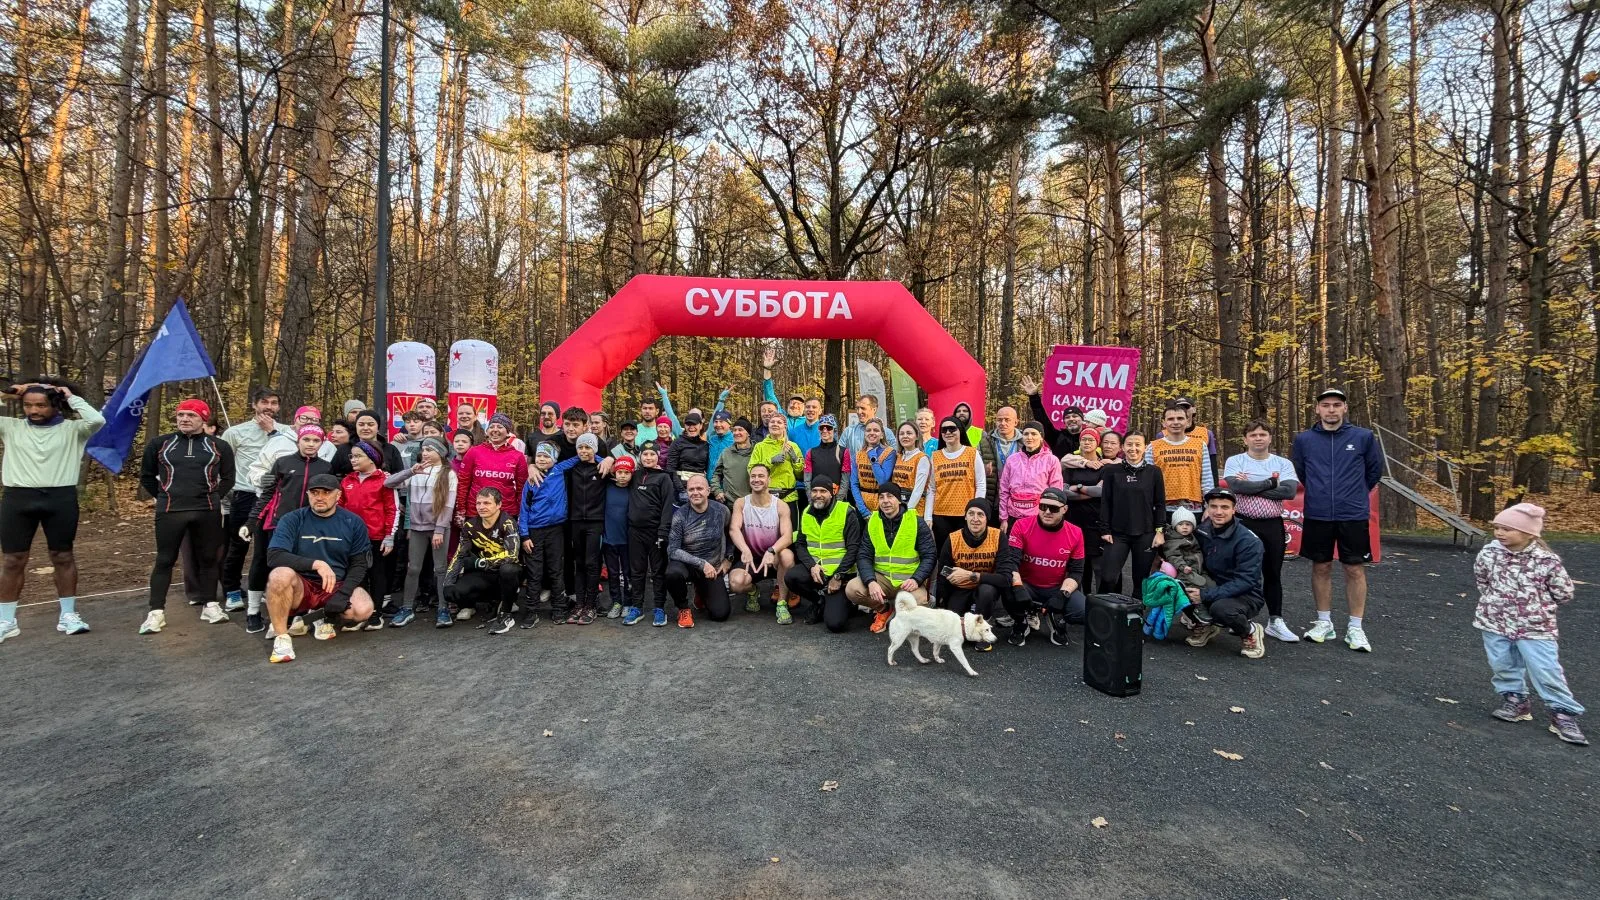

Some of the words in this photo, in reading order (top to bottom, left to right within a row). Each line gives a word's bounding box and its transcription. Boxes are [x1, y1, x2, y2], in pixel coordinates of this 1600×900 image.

[685, 287, 853, 320] СУББОТА
[1055, 360, 1130, 390] 5КМ
[1052, 394, 1124, 412] КАЖДУЮ
[474, 469, 515, 480] СУББОТА
[1023, 554, 1067, 568] СУББОТА
